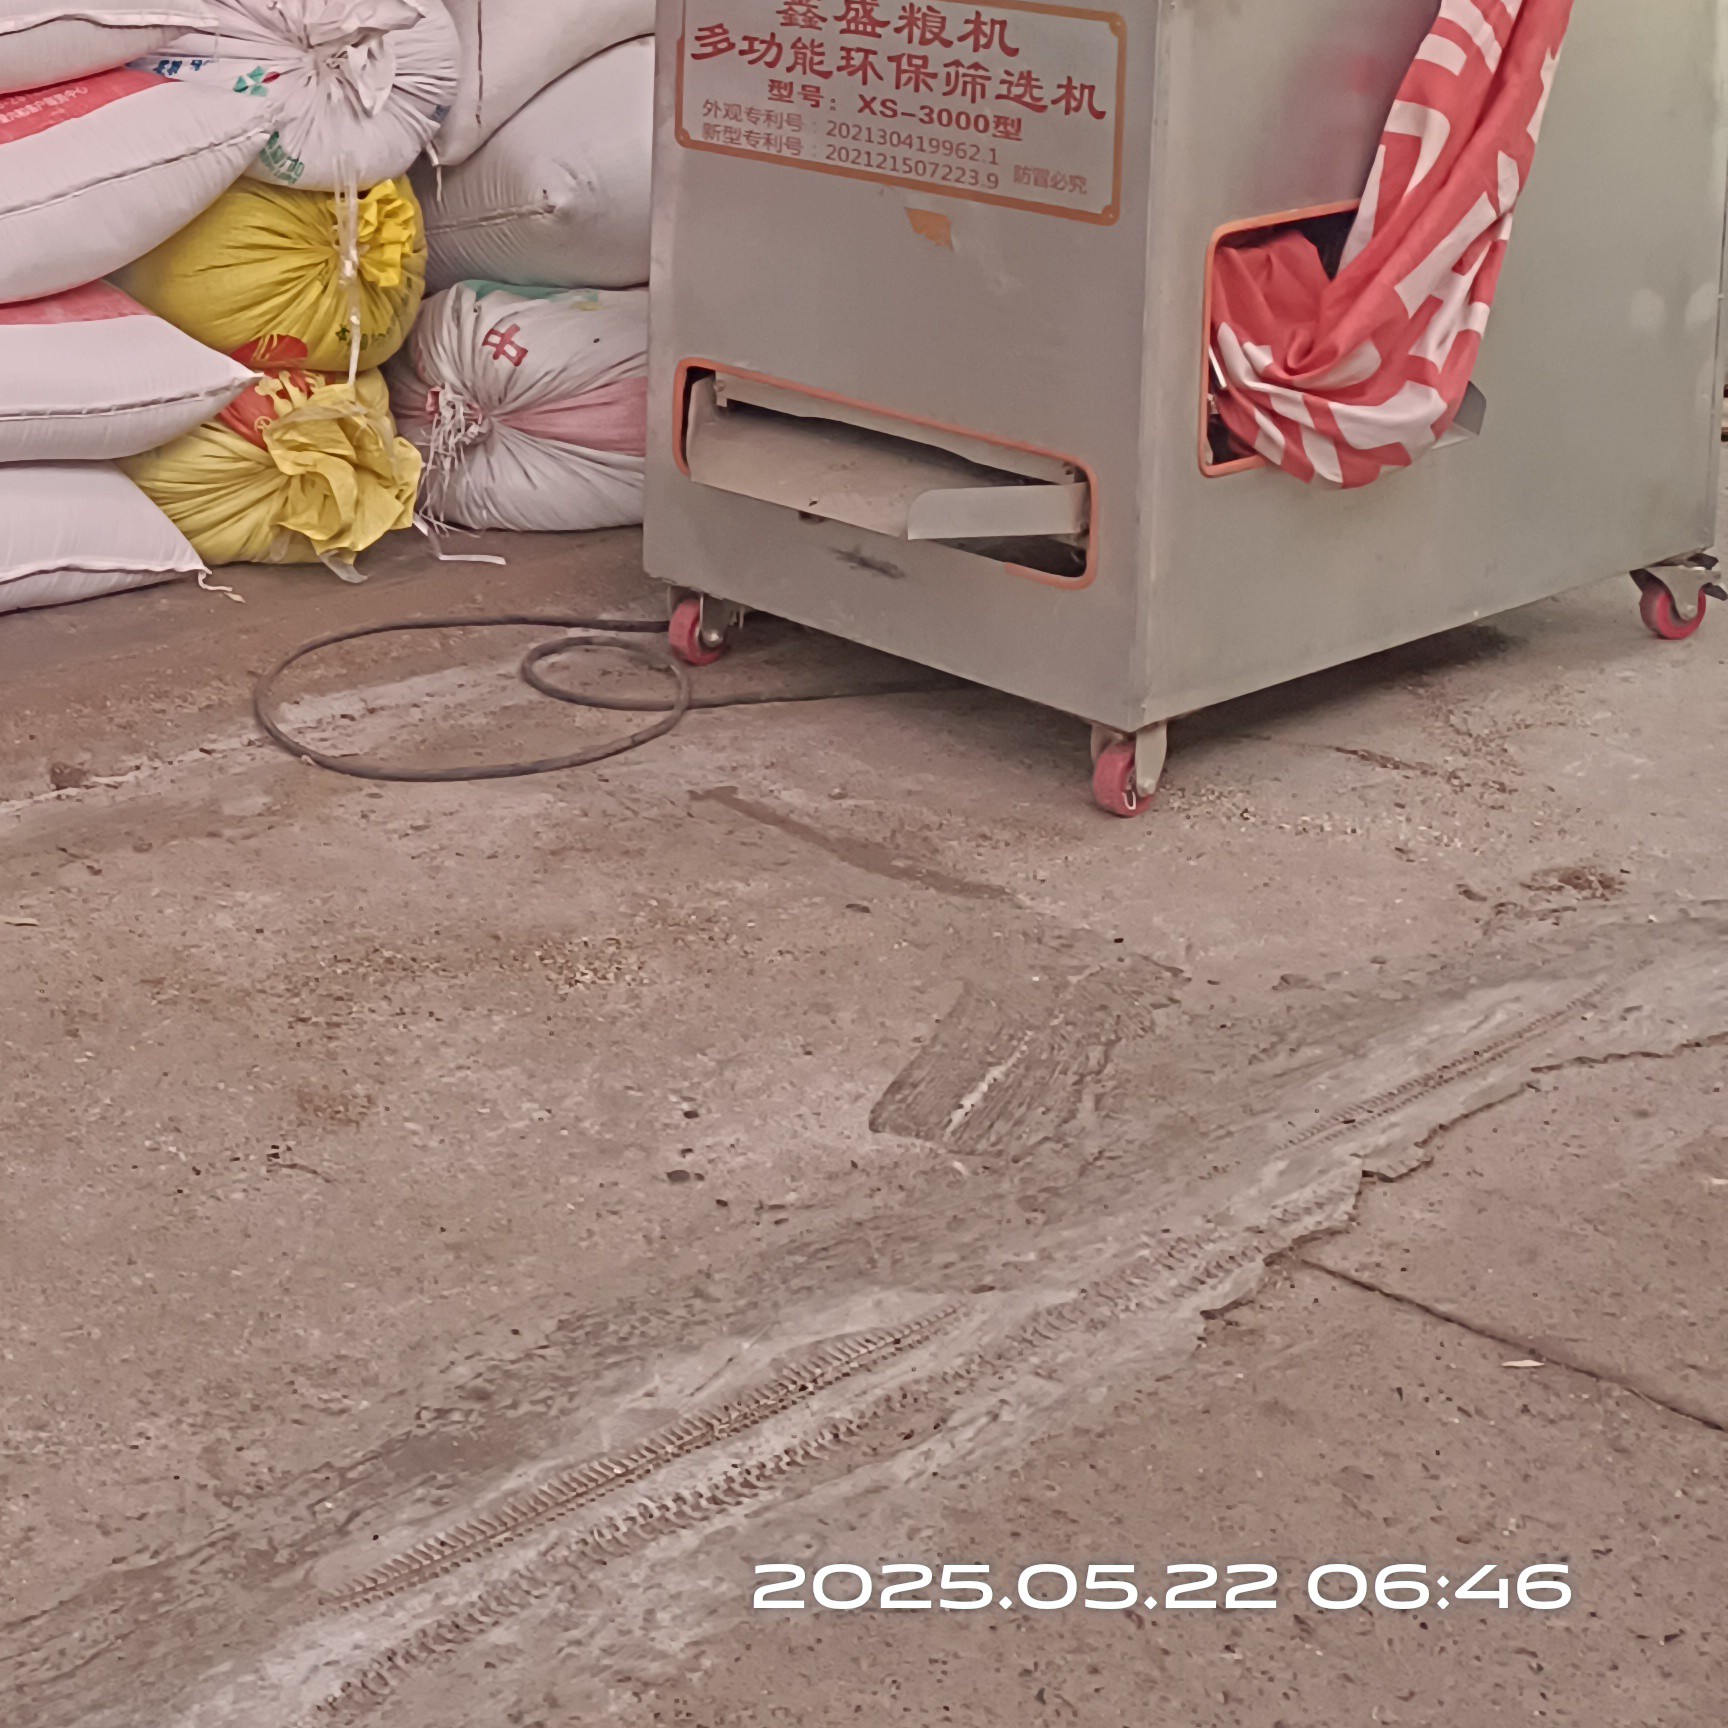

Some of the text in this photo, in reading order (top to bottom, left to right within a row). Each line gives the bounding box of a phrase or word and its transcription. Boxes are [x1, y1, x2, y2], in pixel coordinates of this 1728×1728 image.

[690, 22, 1107, 120] 多功能环保筛选机
